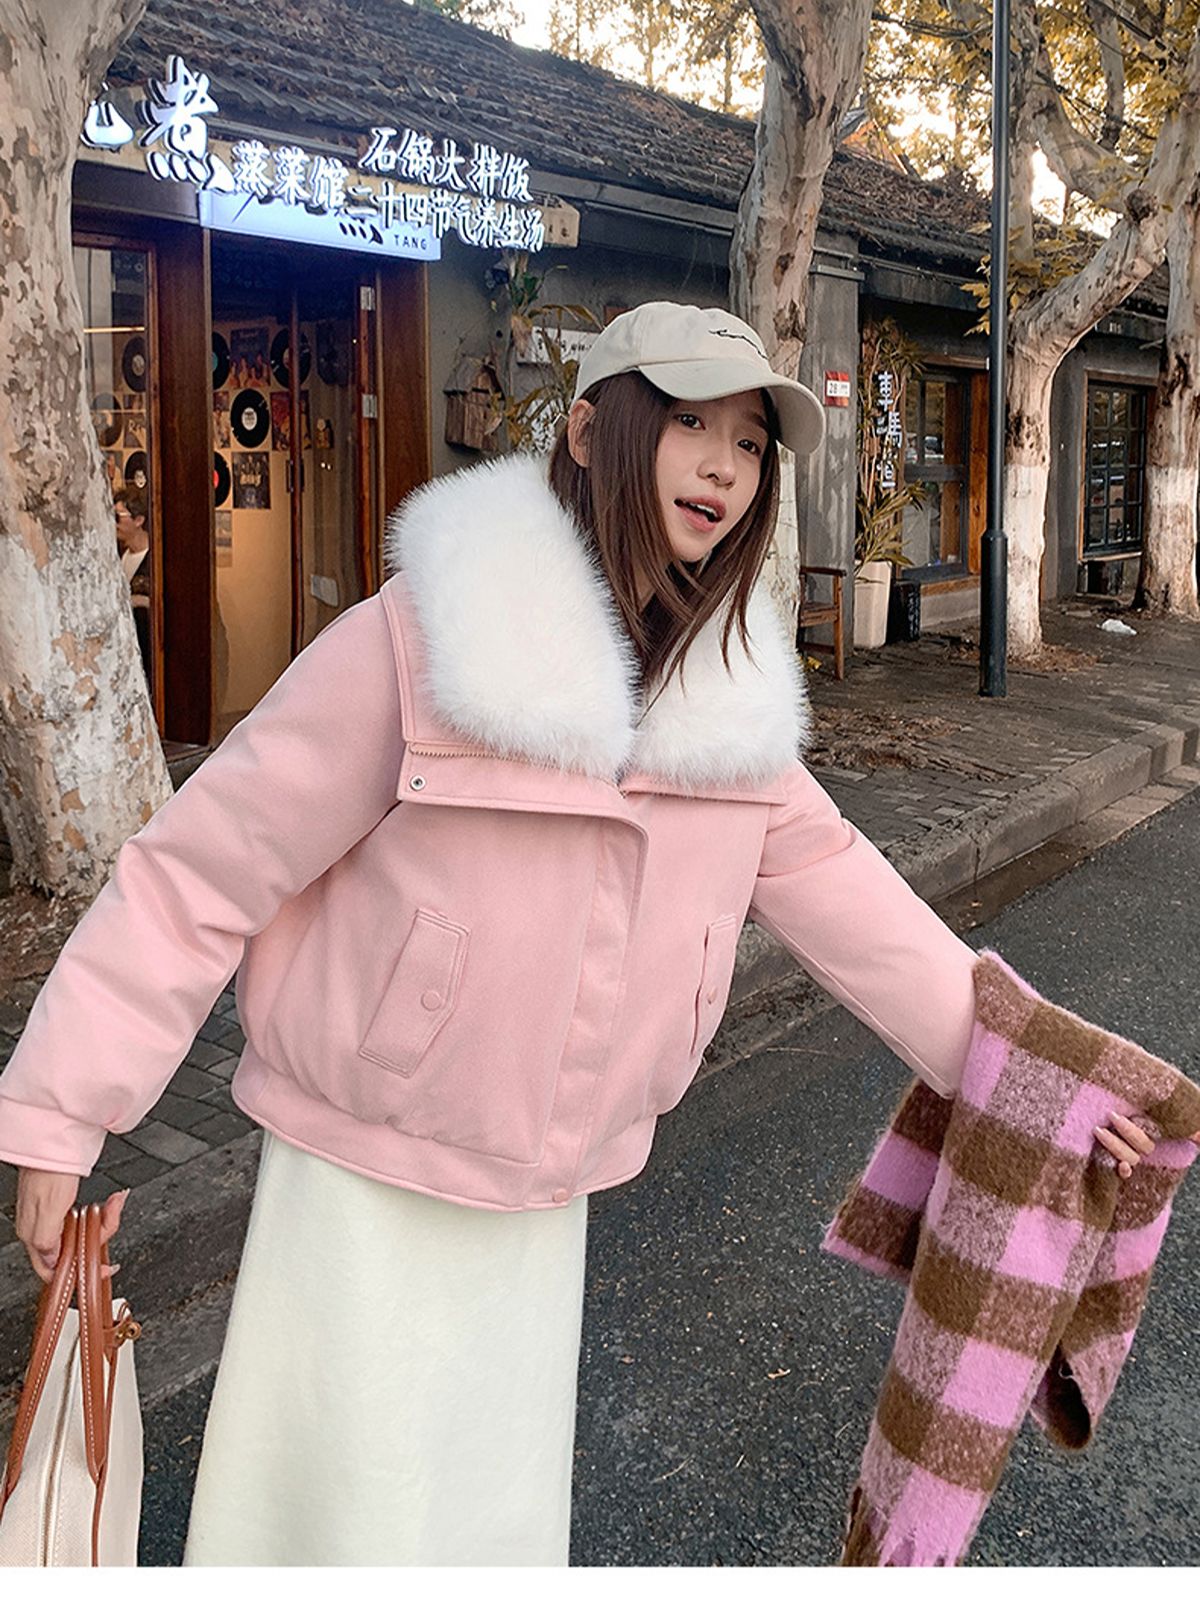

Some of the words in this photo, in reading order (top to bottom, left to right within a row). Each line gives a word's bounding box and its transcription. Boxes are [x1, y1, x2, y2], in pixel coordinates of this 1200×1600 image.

[230, 139, 350, 209] 蒸菜馆
[341, 179, 546, 253] 二十四节气养生汤
[393, 233, 428, 251] TANG
